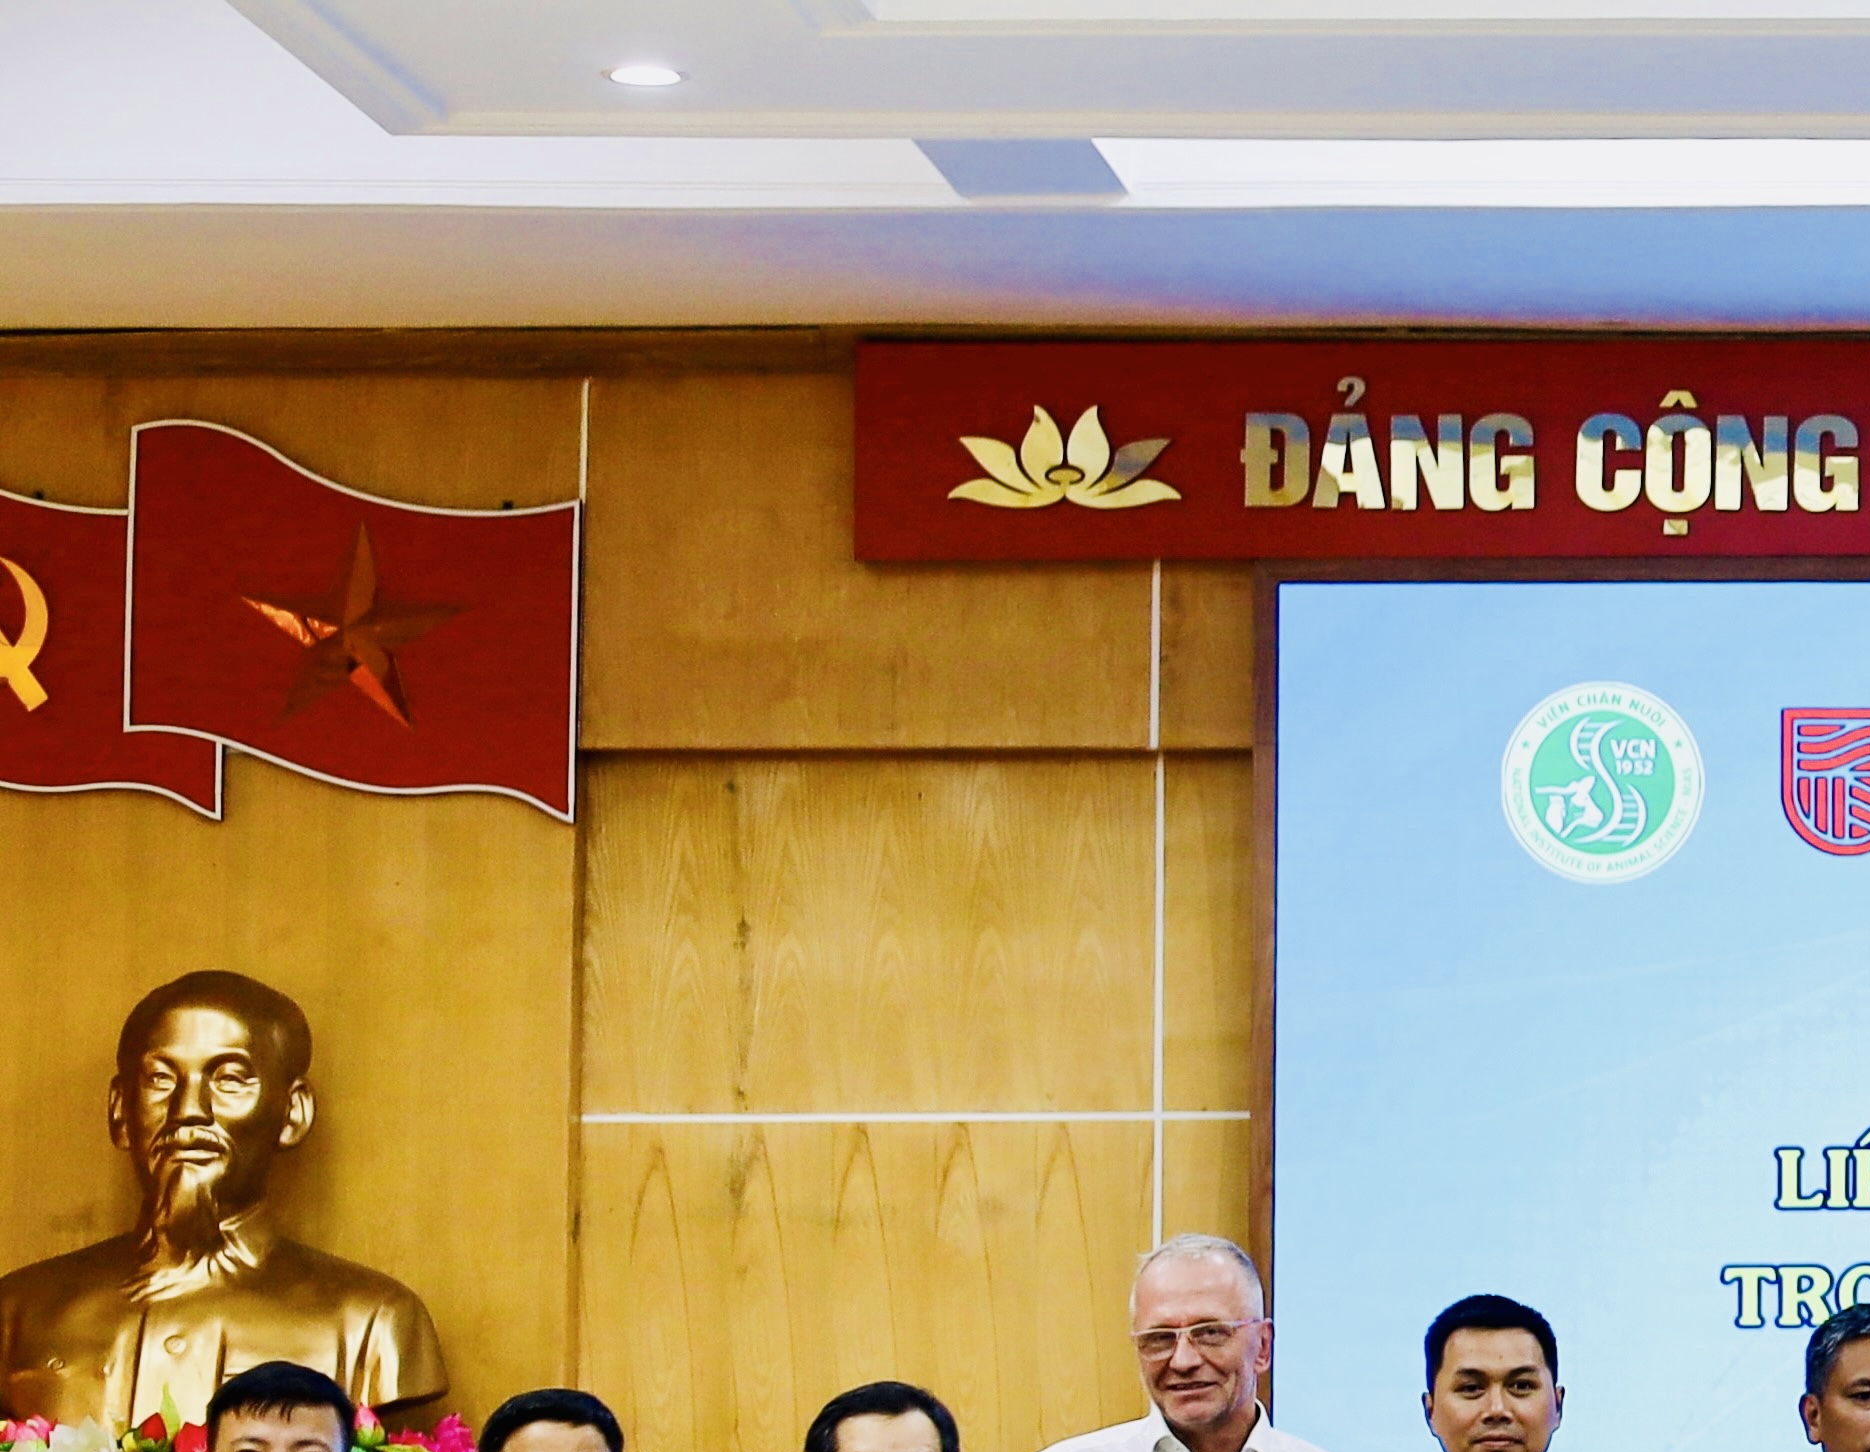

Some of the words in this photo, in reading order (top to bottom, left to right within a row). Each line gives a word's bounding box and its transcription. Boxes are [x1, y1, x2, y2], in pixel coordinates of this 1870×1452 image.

[1240, 376, 1534, 514] ĐẢNG
[1574, 389, 1860, 536] CỘNG
[1610, 738, 1656, 759] VCN
[1616, 759, 1654, 776] 1952
